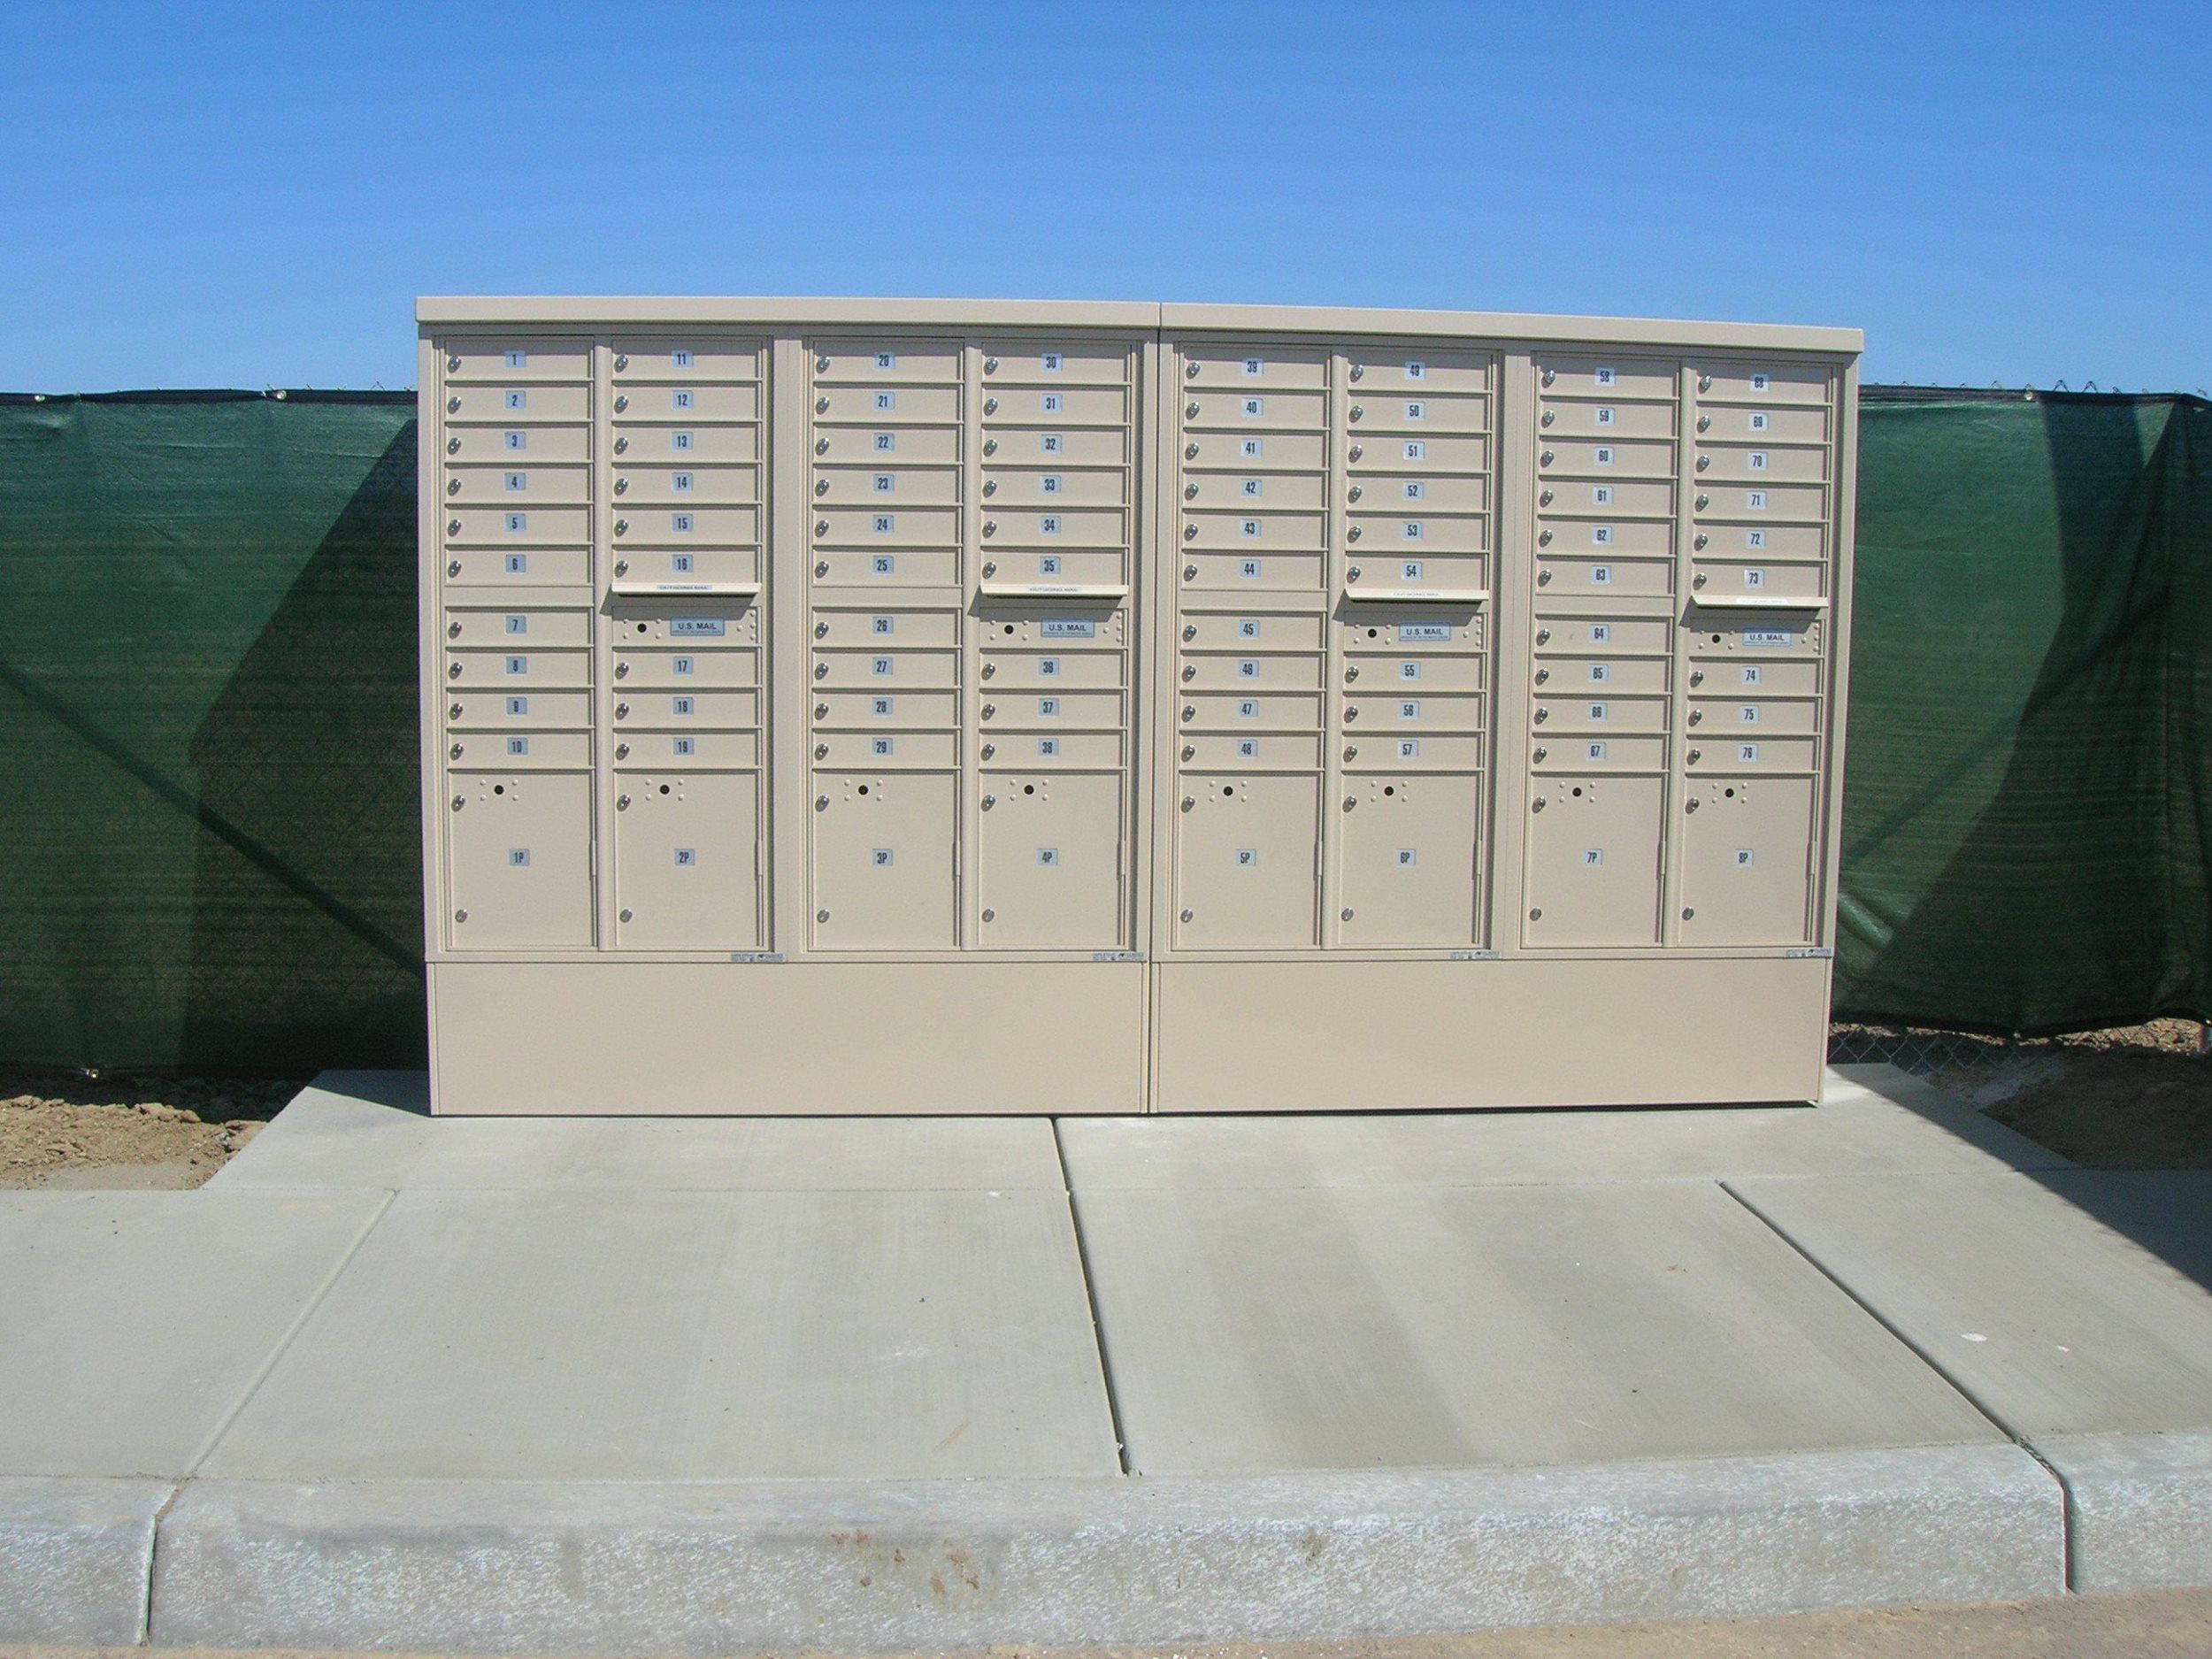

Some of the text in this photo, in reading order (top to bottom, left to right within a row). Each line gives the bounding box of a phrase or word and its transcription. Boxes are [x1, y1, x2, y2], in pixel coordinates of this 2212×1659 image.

[677, 353, 687, 365] 11
[879, 354, 889, 367] 20
[1046, 356, 1056, 369] 30
[1247, 360, 1258, 373] 39
[1600, 371, 1610, 383] 58
[677, 394, 687, 406] 12
[878, 395, 888, 408] 21
[1046, 396, 1056, 410] 31
[1246, 401, 1257, 414] 40
[1409, 404, 1419, 417] 50
[677, 434, 687, 448] 13
[878, 435, 889, 449] 22
[1045, 437, 1056, 450] 32
[1245, 442, 1256, 454] 41
[1408, 444, 1417, 457] 51
[677, 476, 687, 488] 14
[877, 477, 888, 490] 23
[1044, 478, 1056, 491] 33
[1245, 481, 1256, 494] 42
[1408, 484, 1418, 497] 52
[1597, 489, 1607, 502] 61
[1751, 494, 1761, 506] 71
[677, 517, 687, 530] 15
[877, 518, 888, 531] 24
[1044, 518, 1056, 532] 34
[1244, 522, 1256, 534] 43
[1407, 524, 1418, 537] 53
[1596, 529, 1608, 541] 62
[1750, 533, 1761, 545] 72
[677, 557, 687, 571] 16
[877, 558, 888, 572] 25
[1043, 559, 1055, 572] 35
[1244, 563, 1255, 575] 44
[1406, 565, 1417, 578] 54
[1748, 572, 1759, 585] 73
[876, 619, 887, 632] 26
[1242, 623, 1254, 636] 45
[1594, 627, 1604, 640] 64
[677, 659, 687, 672] 17
[876, 660, 887, 673] 27
[1404, 664, 1415, 677] 55
[1746, 669, 1756, 681] 74
[678, 700, 688, 713] 18
[876, 700, 887, 714] 28
[1042, 701, 1054, 714] 37
[1241, 703, 1253, 715] 47
[1744, 708, 1755, 721] 75
[511, 741, 522, 753] 10
[876, 741, 887, 754] 29
[1402, 743, 1413, 756] 57
[1590, 745, 1601, 757] 67
[514, 851, 525, 864] 1P
[679, 851, 689, 864] 2P
[877, 852, 887, 864] 3P
[1041, 851, 1053, 864] 4P
[1240, 852, 1251, 864] 5P
[1586, 851, 1598, 864] 7P
